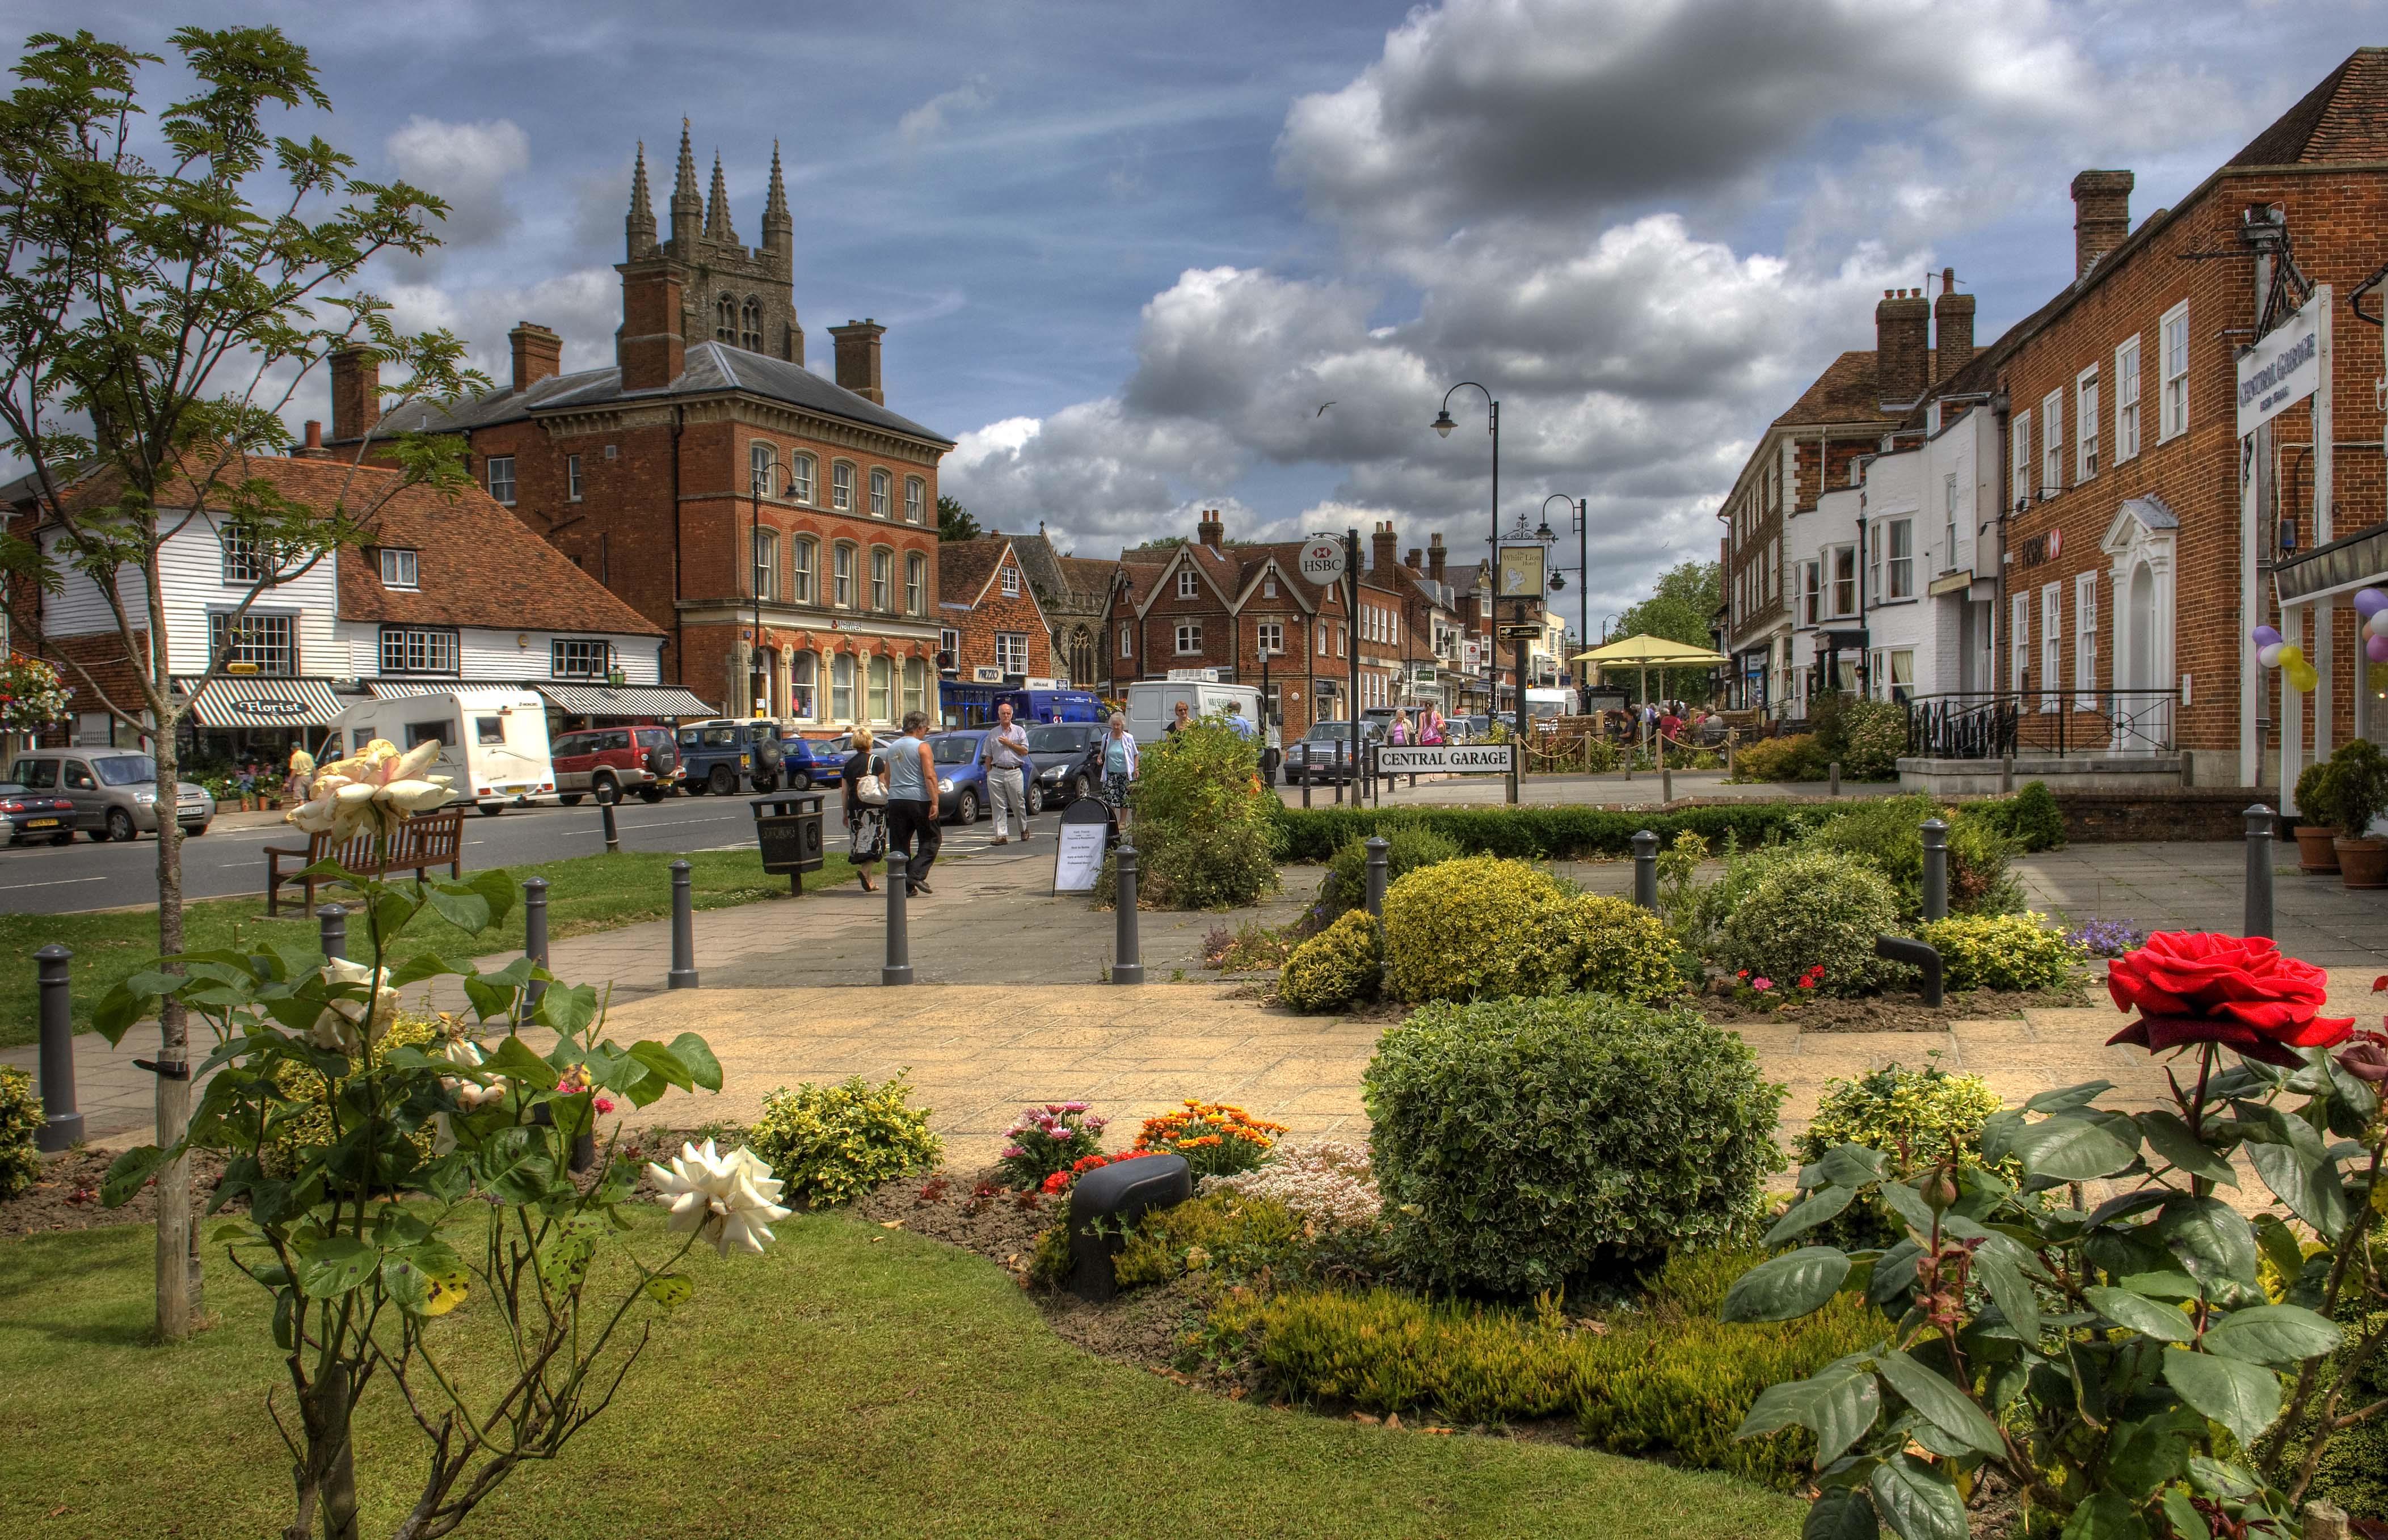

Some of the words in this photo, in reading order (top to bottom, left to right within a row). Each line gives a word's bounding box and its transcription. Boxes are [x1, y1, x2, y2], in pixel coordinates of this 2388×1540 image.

[2239, 362, 2277, 407] CENTRAL
[2277, 332, 2315, 381] GARAGE
[2022, 533, 2049, 567] HSBC
[1304, 559, 1342, 572] HSBC
[838, 620, 862, 631] NatWest
[978, 669, 999, 680] PREZZO
[239, 701, 302, 712] Florist
[1382, 753, 1446, 765] CENTRAL
[1450, 752, 1507, 765] GARAGE
